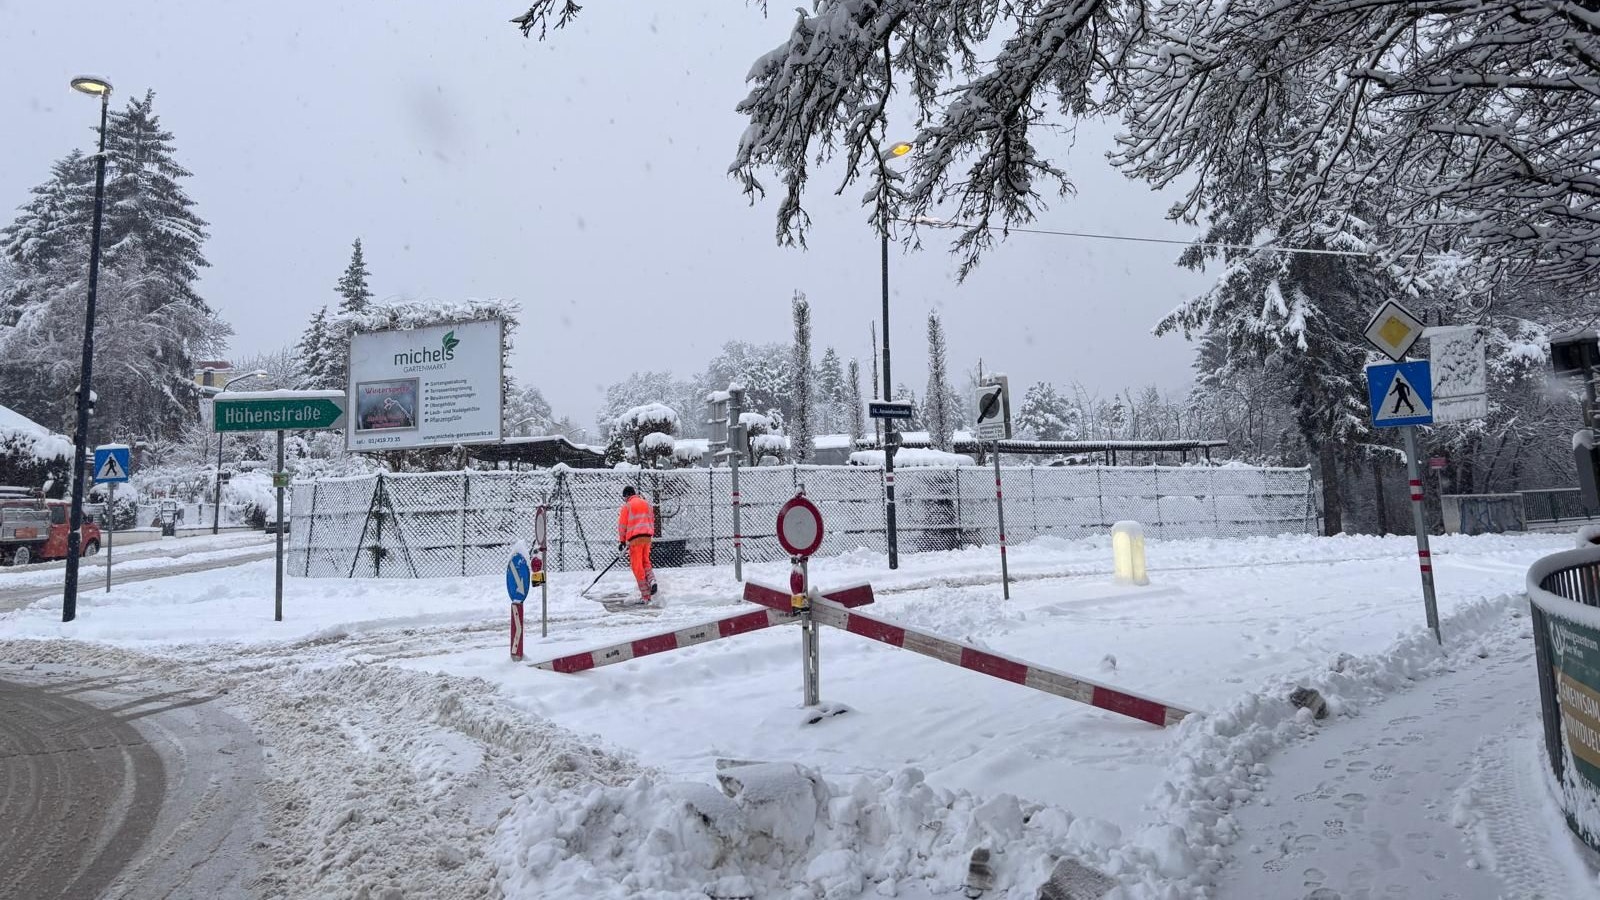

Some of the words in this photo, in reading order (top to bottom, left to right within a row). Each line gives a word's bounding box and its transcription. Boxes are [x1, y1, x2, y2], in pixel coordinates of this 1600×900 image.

[395, 346, 454, 365] michels
[403, 363, 447, 373] GARTENMARKT
[225, 406, 321, 424] Höhenstraße
